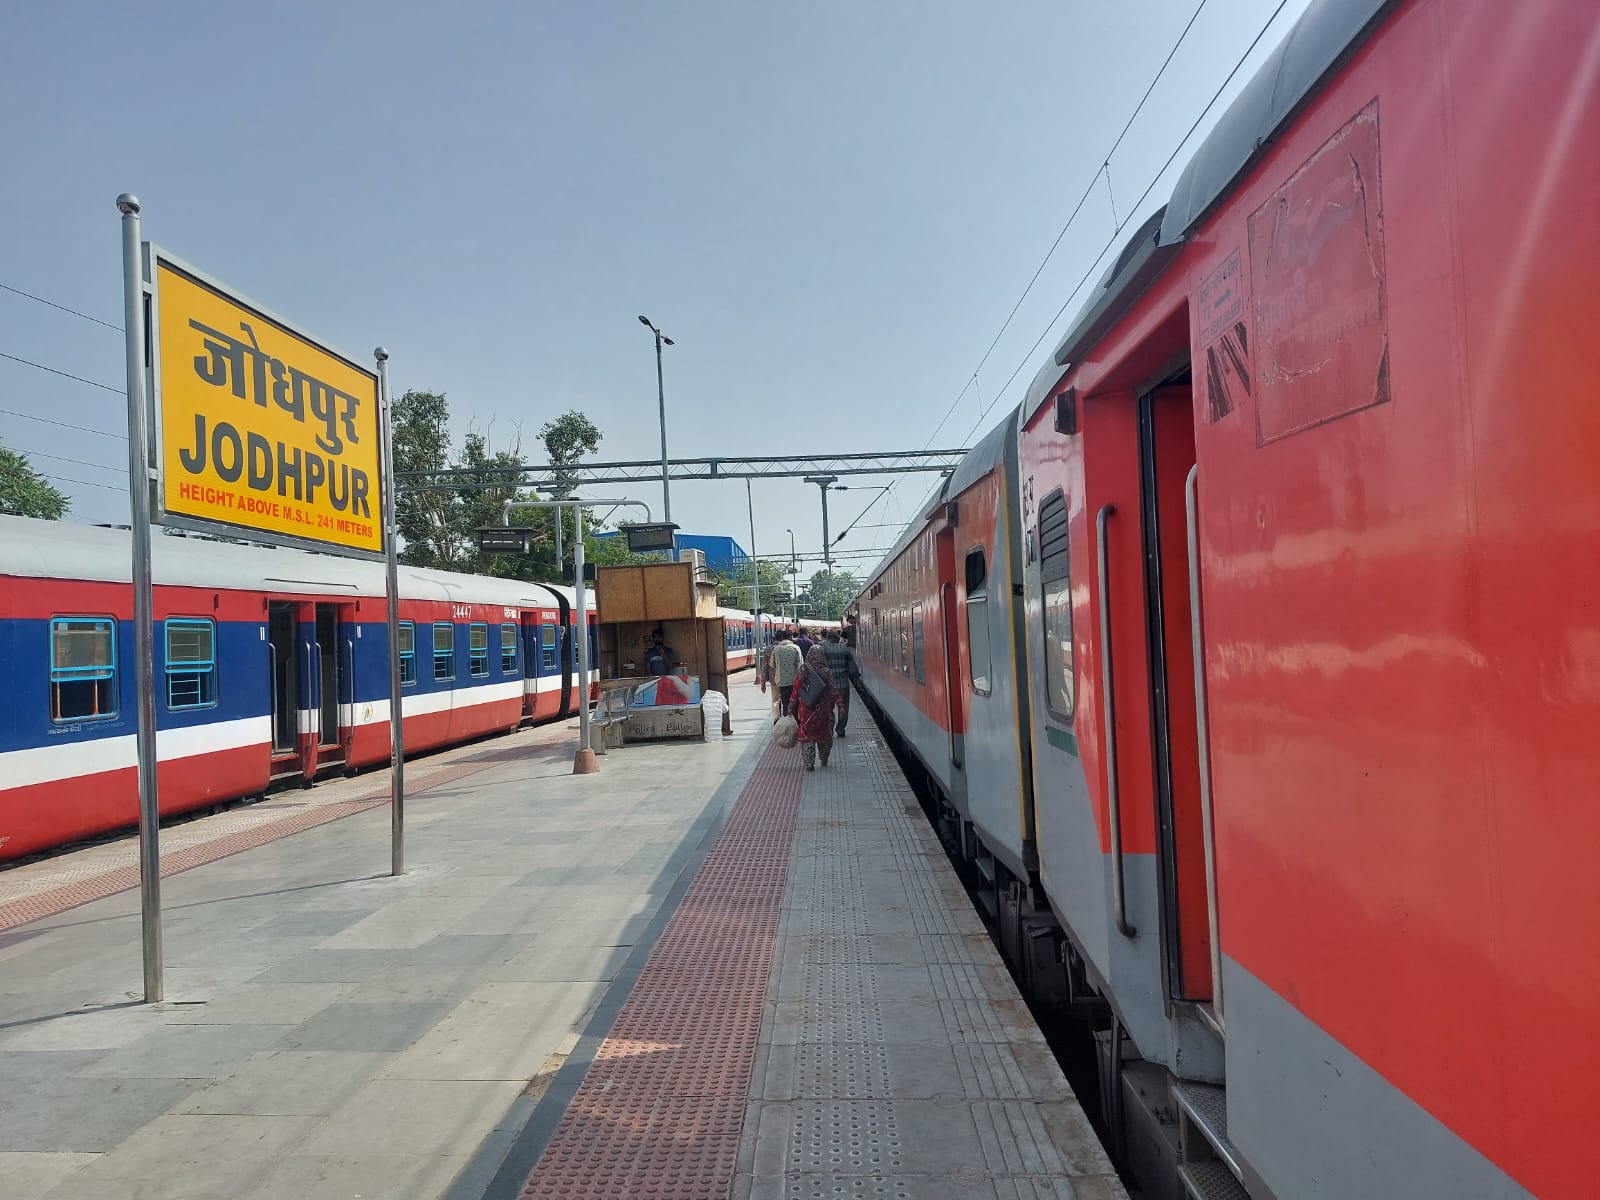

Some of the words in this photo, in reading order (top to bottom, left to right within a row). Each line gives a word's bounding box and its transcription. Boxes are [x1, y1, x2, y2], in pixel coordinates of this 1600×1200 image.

[189, 317, 360, 455] जोधपुर
[179, 413, 371, 519] JODHPUR
[179, 482, 235, 508] HEIGHT
[237, 495, 280, 518] ABOVE
[282, 505, 315, 526] M.S.L.
[317, 514, 334, 530] 241
[336, 518, 374, 538] METERS
